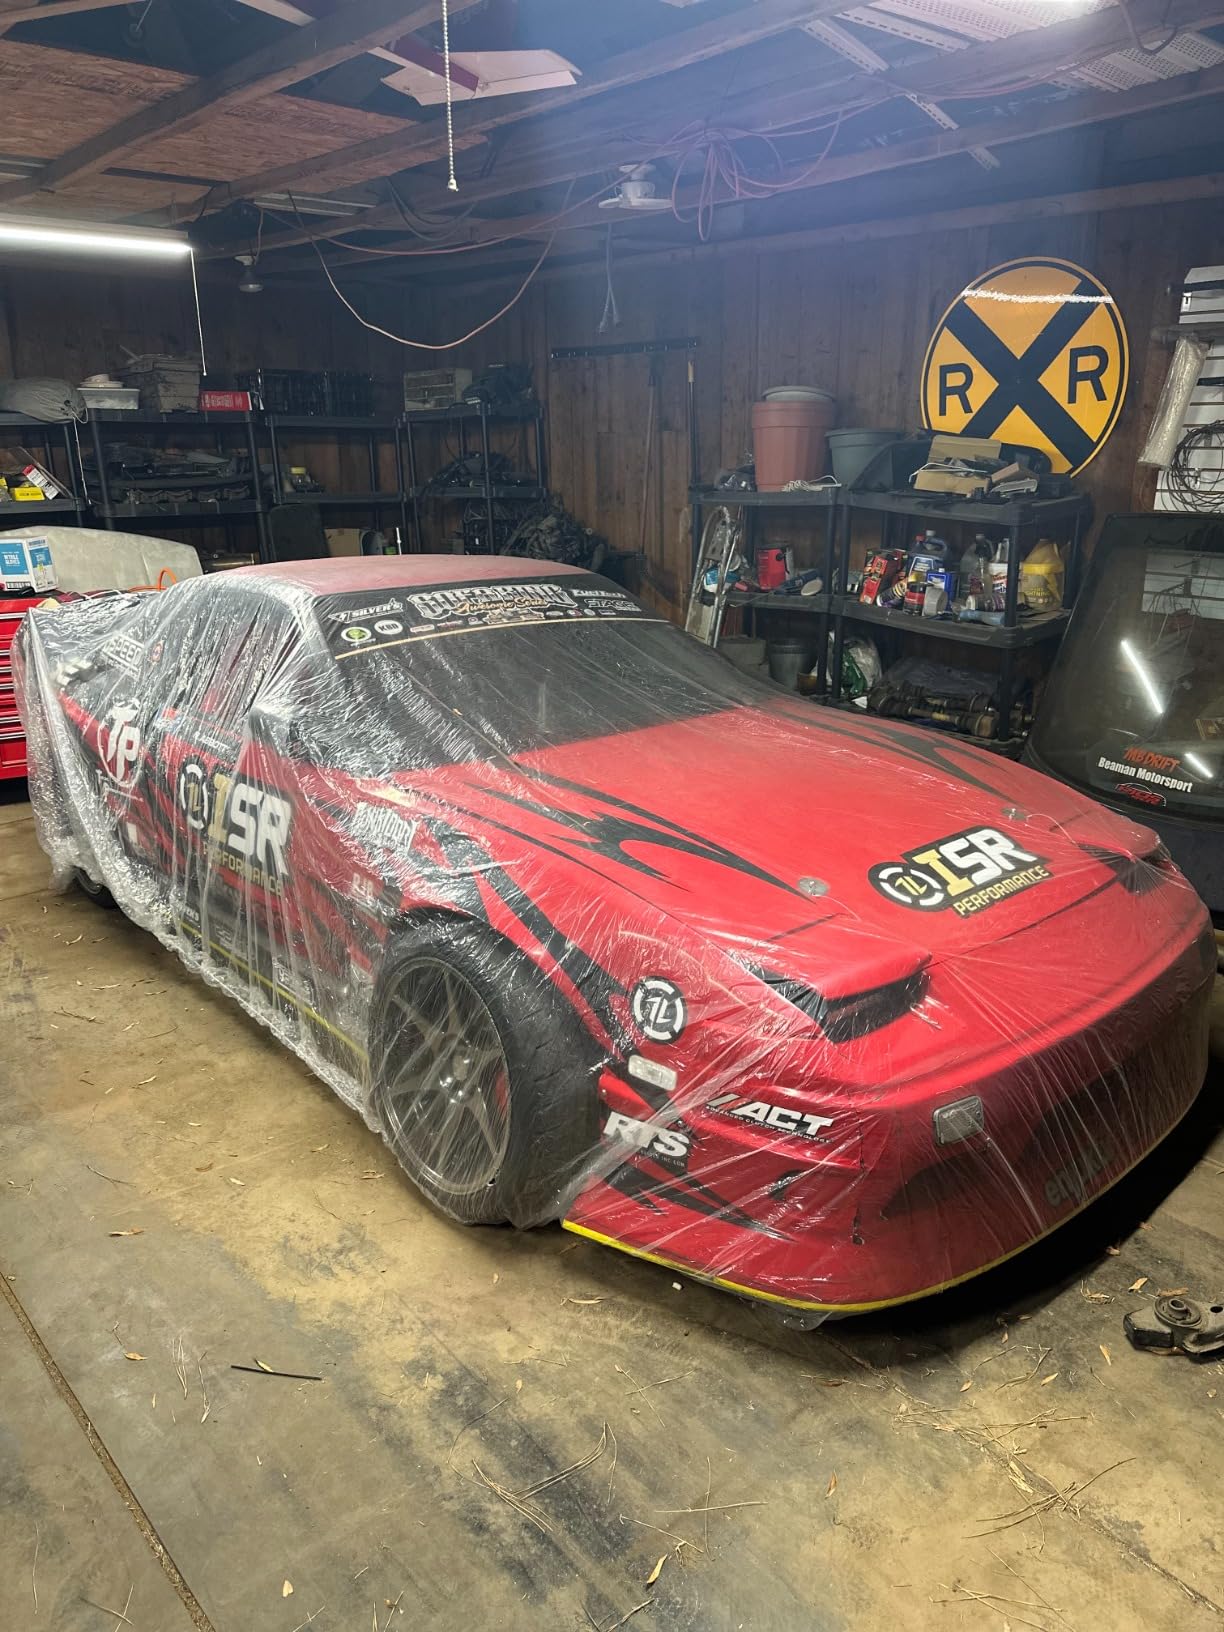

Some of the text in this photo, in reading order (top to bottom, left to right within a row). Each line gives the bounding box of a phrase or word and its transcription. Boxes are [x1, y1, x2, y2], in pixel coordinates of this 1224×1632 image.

[939, 363, 974, 416] R
[1067, 345, 1108, 404] R
[1098, 757, 1193, 793] Beaman Motorsport
[208, 772, 292, 876] ISR
[911, 829, 1038, 897] ISR
[953, 865, 1050, 916] PERFORMANCE
[731, 1101, 834, 1136] ACT
